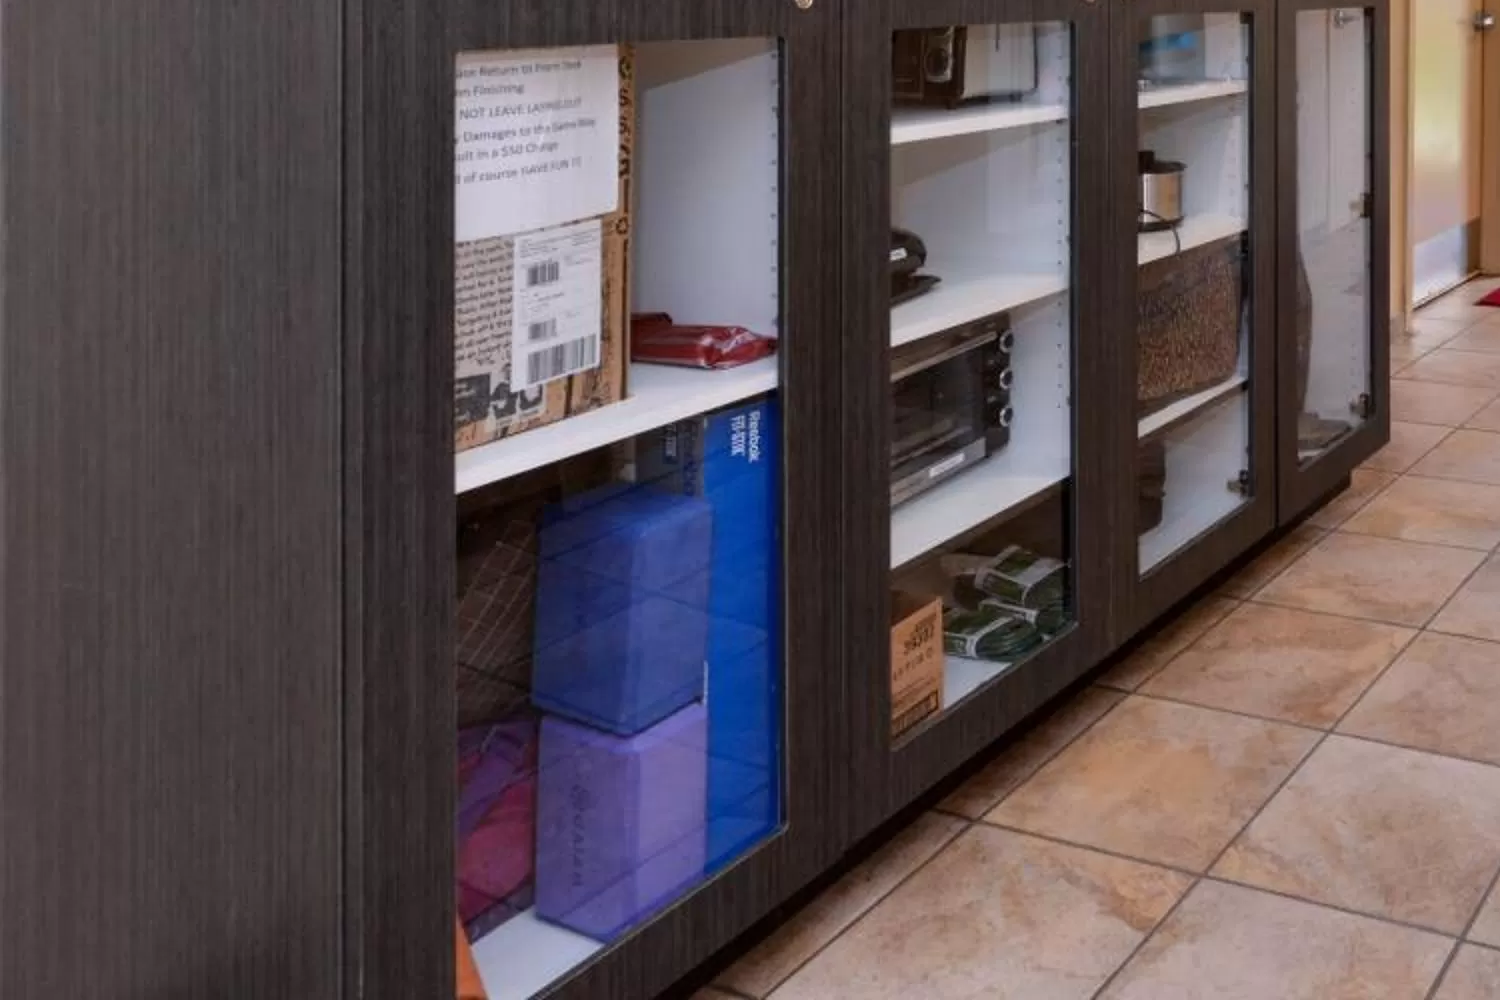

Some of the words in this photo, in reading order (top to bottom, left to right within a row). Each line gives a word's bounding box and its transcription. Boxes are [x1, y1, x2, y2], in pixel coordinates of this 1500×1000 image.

[459, 107, 485, 120] NOT
[489, 105, 524, 118] LEAVE
[463, 127, 517, 143] Damages
